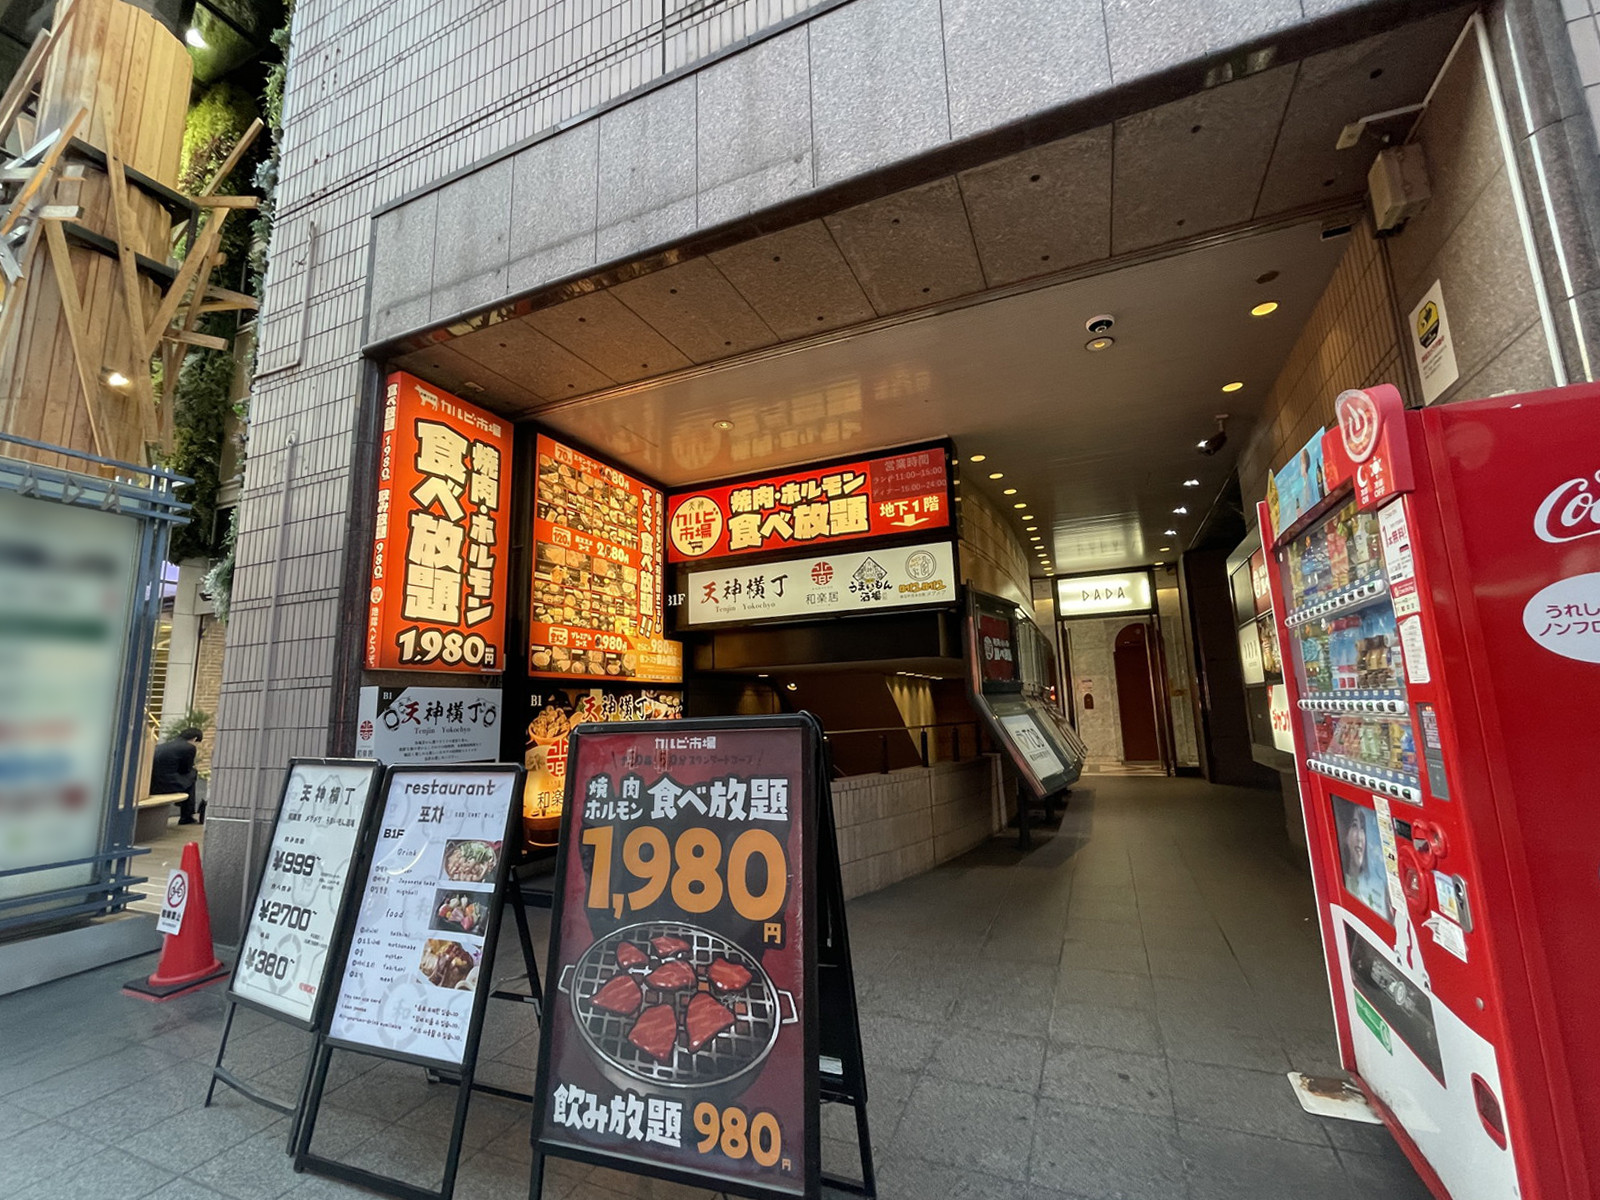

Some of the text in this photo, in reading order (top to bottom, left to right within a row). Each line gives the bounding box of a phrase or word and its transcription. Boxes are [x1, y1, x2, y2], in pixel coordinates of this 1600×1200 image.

[441, 400, 502, 438] カルビ市場
[884, 453, 930, 472] 営業時間
[730, 472, 866, 513] 焼肉・ホルモン
[879, 495, 940, 518] 地下1階
[404, 421, 470, 624] 食べ放題
[675, 507, 719, 528] カルビ
[727, 495, 869, 550] 食べ放題
[467, 442, 499, 625] 焼肉・ホルモン
[680, 523, 712, 541] 市場
[700, 573, 789, 605] 天神横丁
[848, 580, 893, 594] うまいもん
[1081, 586, 1126, 602] DADA
[715, 605, 736, 614] Tenjin
[383, 692, 392, 700] B1
[530, 694, 542, 706] B1
[401, 700, 483, 726] 天神横丁
[582, 693, 649, 722] 天神横丁
[414, 726, 436, 736] Tenjin
[655, 736, 717, 750] カルビ市場
[300, 784, 356, 805] 天神横丁
[404, 779, 496, 796] restaurant
[588, 776, 640, 799] 焼肉
[647, 777, 789, 821] 食べ放題
[417, 805, 445, 824] 포차
[584, 801, 644, 821] ホルモン
[383, 828, 406, 839] B1F
[386, 908, 405, 919] food
[553, 1083, 683, 1148] 飲み放題
